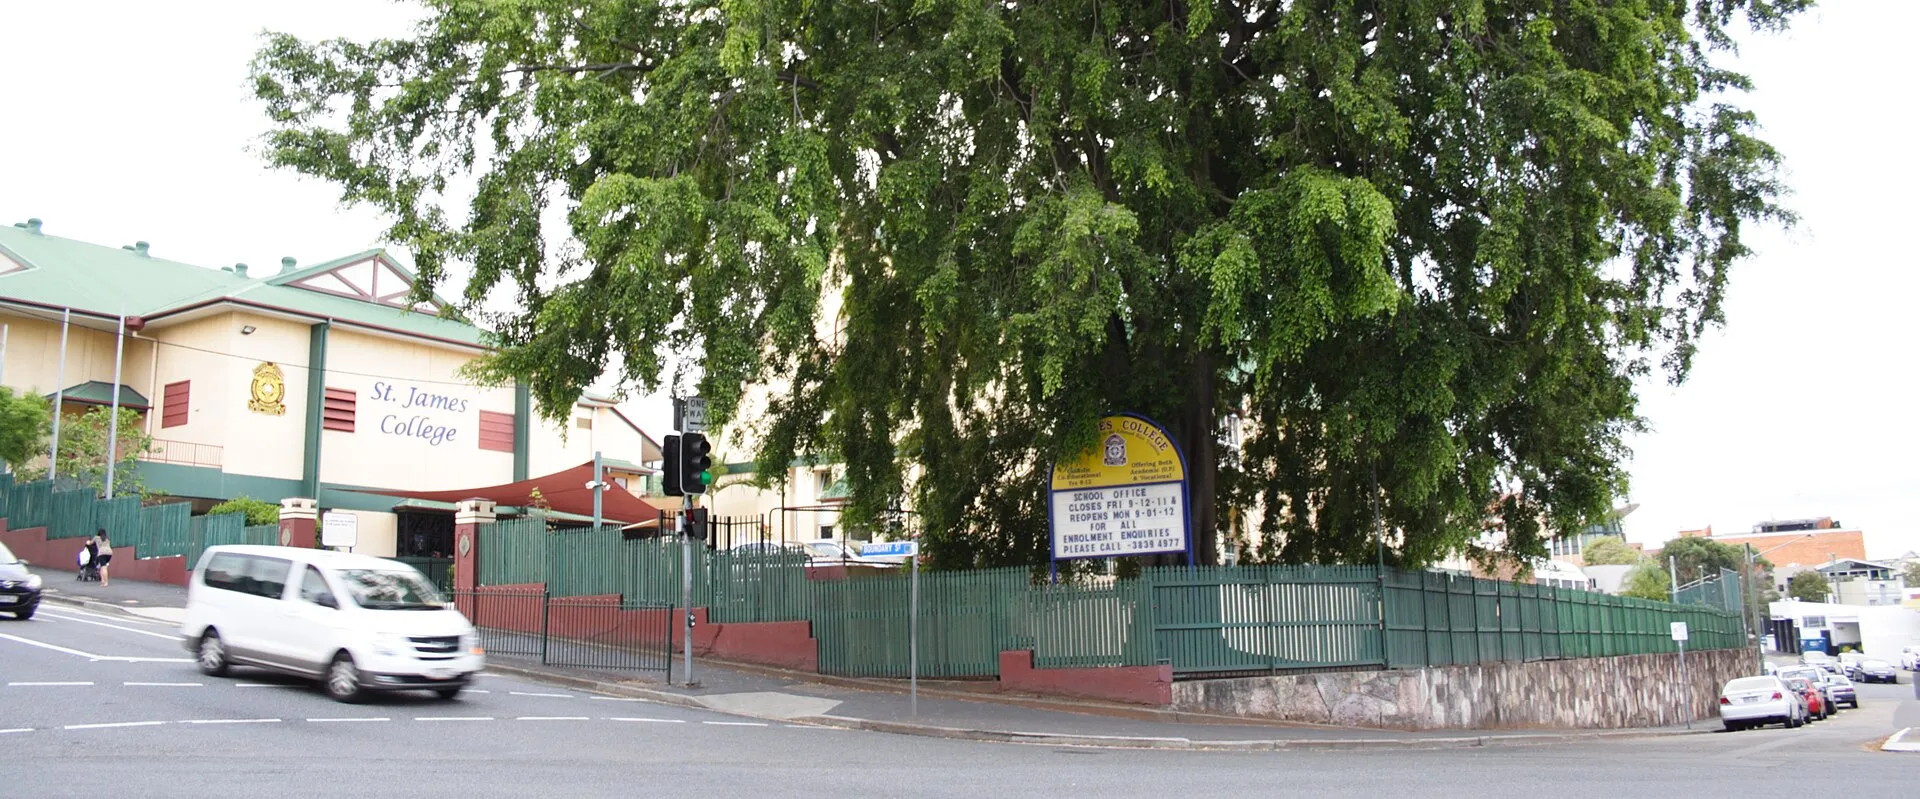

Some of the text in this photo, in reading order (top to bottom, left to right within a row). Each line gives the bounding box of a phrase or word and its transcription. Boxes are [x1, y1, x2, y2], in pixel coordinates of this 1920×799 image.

[371, 382, 468, 412] St. James
[690, 400, 706, 408] ONE
[690, 410, 706, 418] WAY
[381, 414, 457, 446] College
[1122, 420, 1168, 451] COLLEGE
[1073, 488, 1147, 502] SCHOOL OFFICE
[1068, 496, 1176, 512] CLOSES FRI 9-12-11 &
[1070, 507, 1174, 522] REOPENS MON 9-01-12
[1090, 520, 1136, 531] FOR ALL
[1063, 528, 1170, 544] ENROLMENT ENQUIRIES
[1063, 544, 1095, 554] PLEASE
[1100, 542, 1121, 551] CALL
[1157, 538, 1179, 548] 4977
